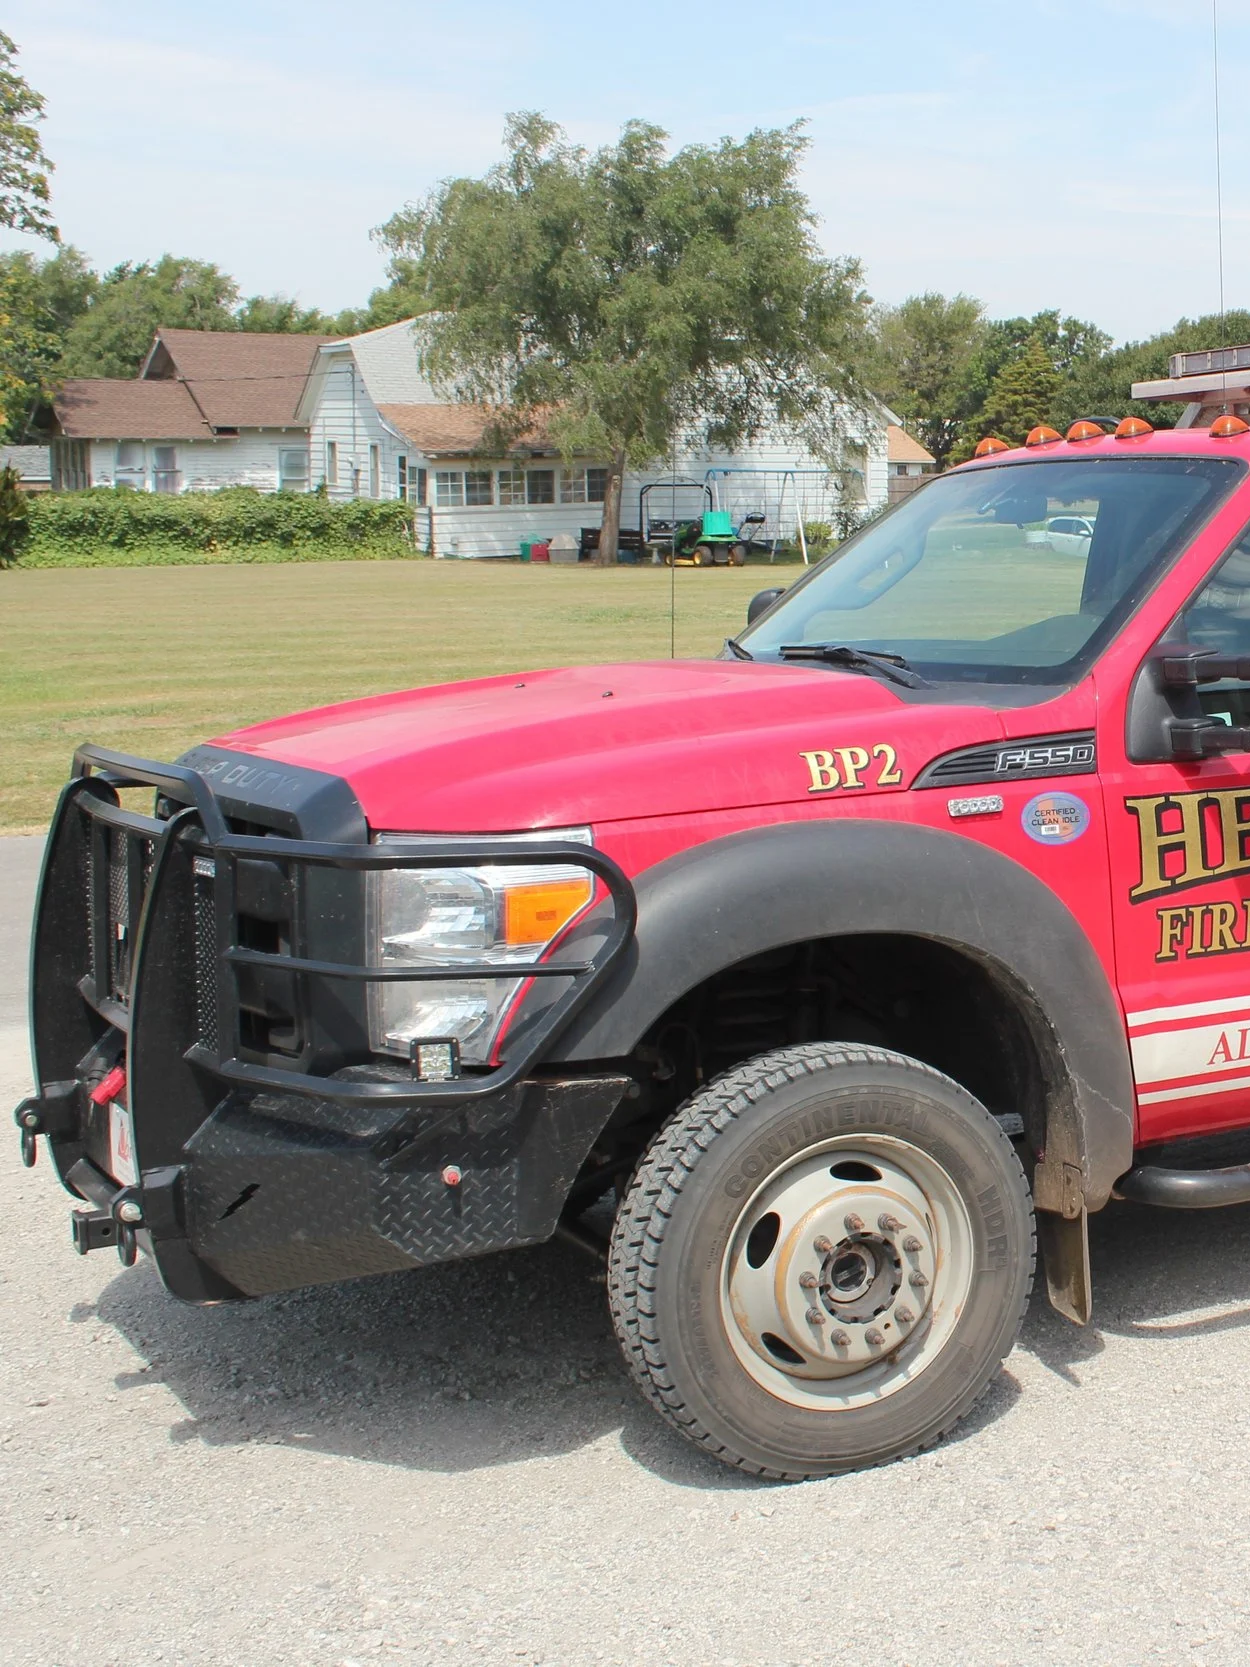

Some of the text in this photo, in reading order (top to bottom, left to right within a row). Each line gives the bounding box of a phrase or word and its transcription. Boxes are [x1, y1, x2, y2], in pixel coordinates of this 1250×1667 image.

[221, 764, 299, 795] DUTY
[799, 743, 902, 792] BP2
[1031, 815, 1081, 826] CLEAN IDLE
[1035, 807, 1076, 817] CERTIFIED
[724, 1099, 930, 1199] CONTINENTAL
